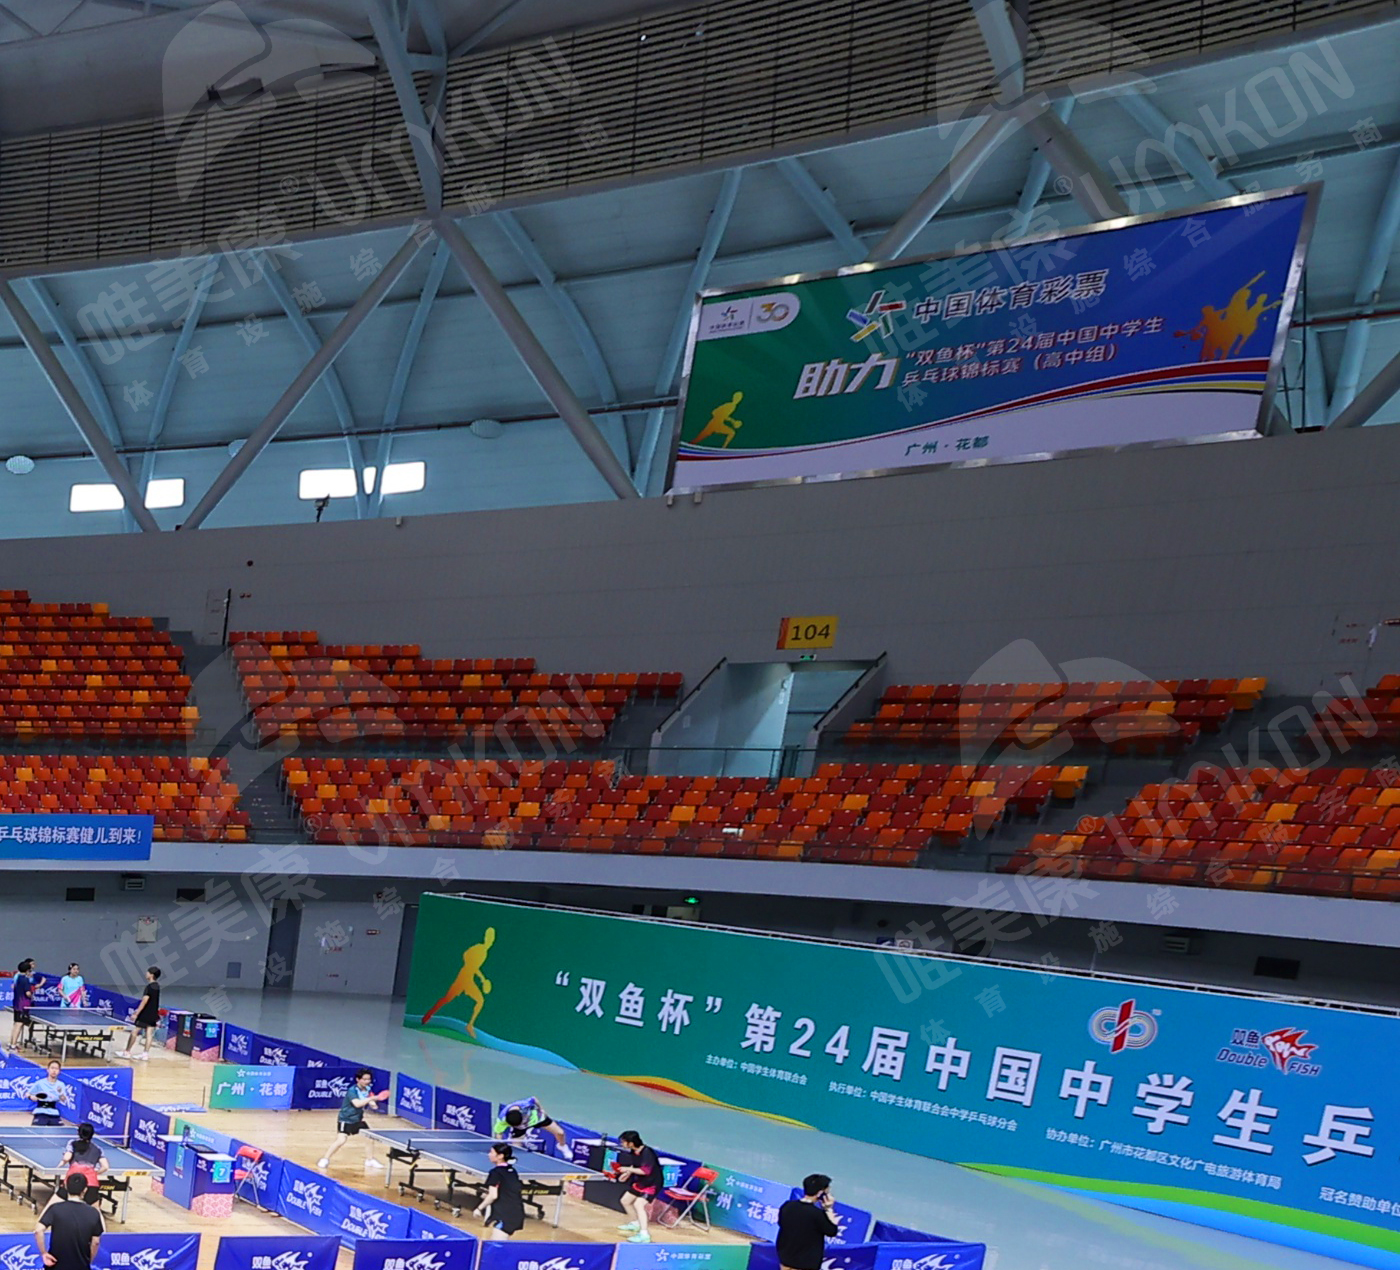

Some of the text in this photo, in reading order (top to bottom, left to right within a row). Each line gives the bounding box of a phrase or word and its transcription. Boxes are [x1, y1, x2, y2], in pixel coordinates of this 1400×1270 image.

[912, 268, 1109, 324] 中国体育彩票
[792, 353, 898, 400] 助力
[790, 623, 831, 641] 104
[1216, 1046, 1322, 1077] Double FISH
[220, 1168, 226, 1177] 7
